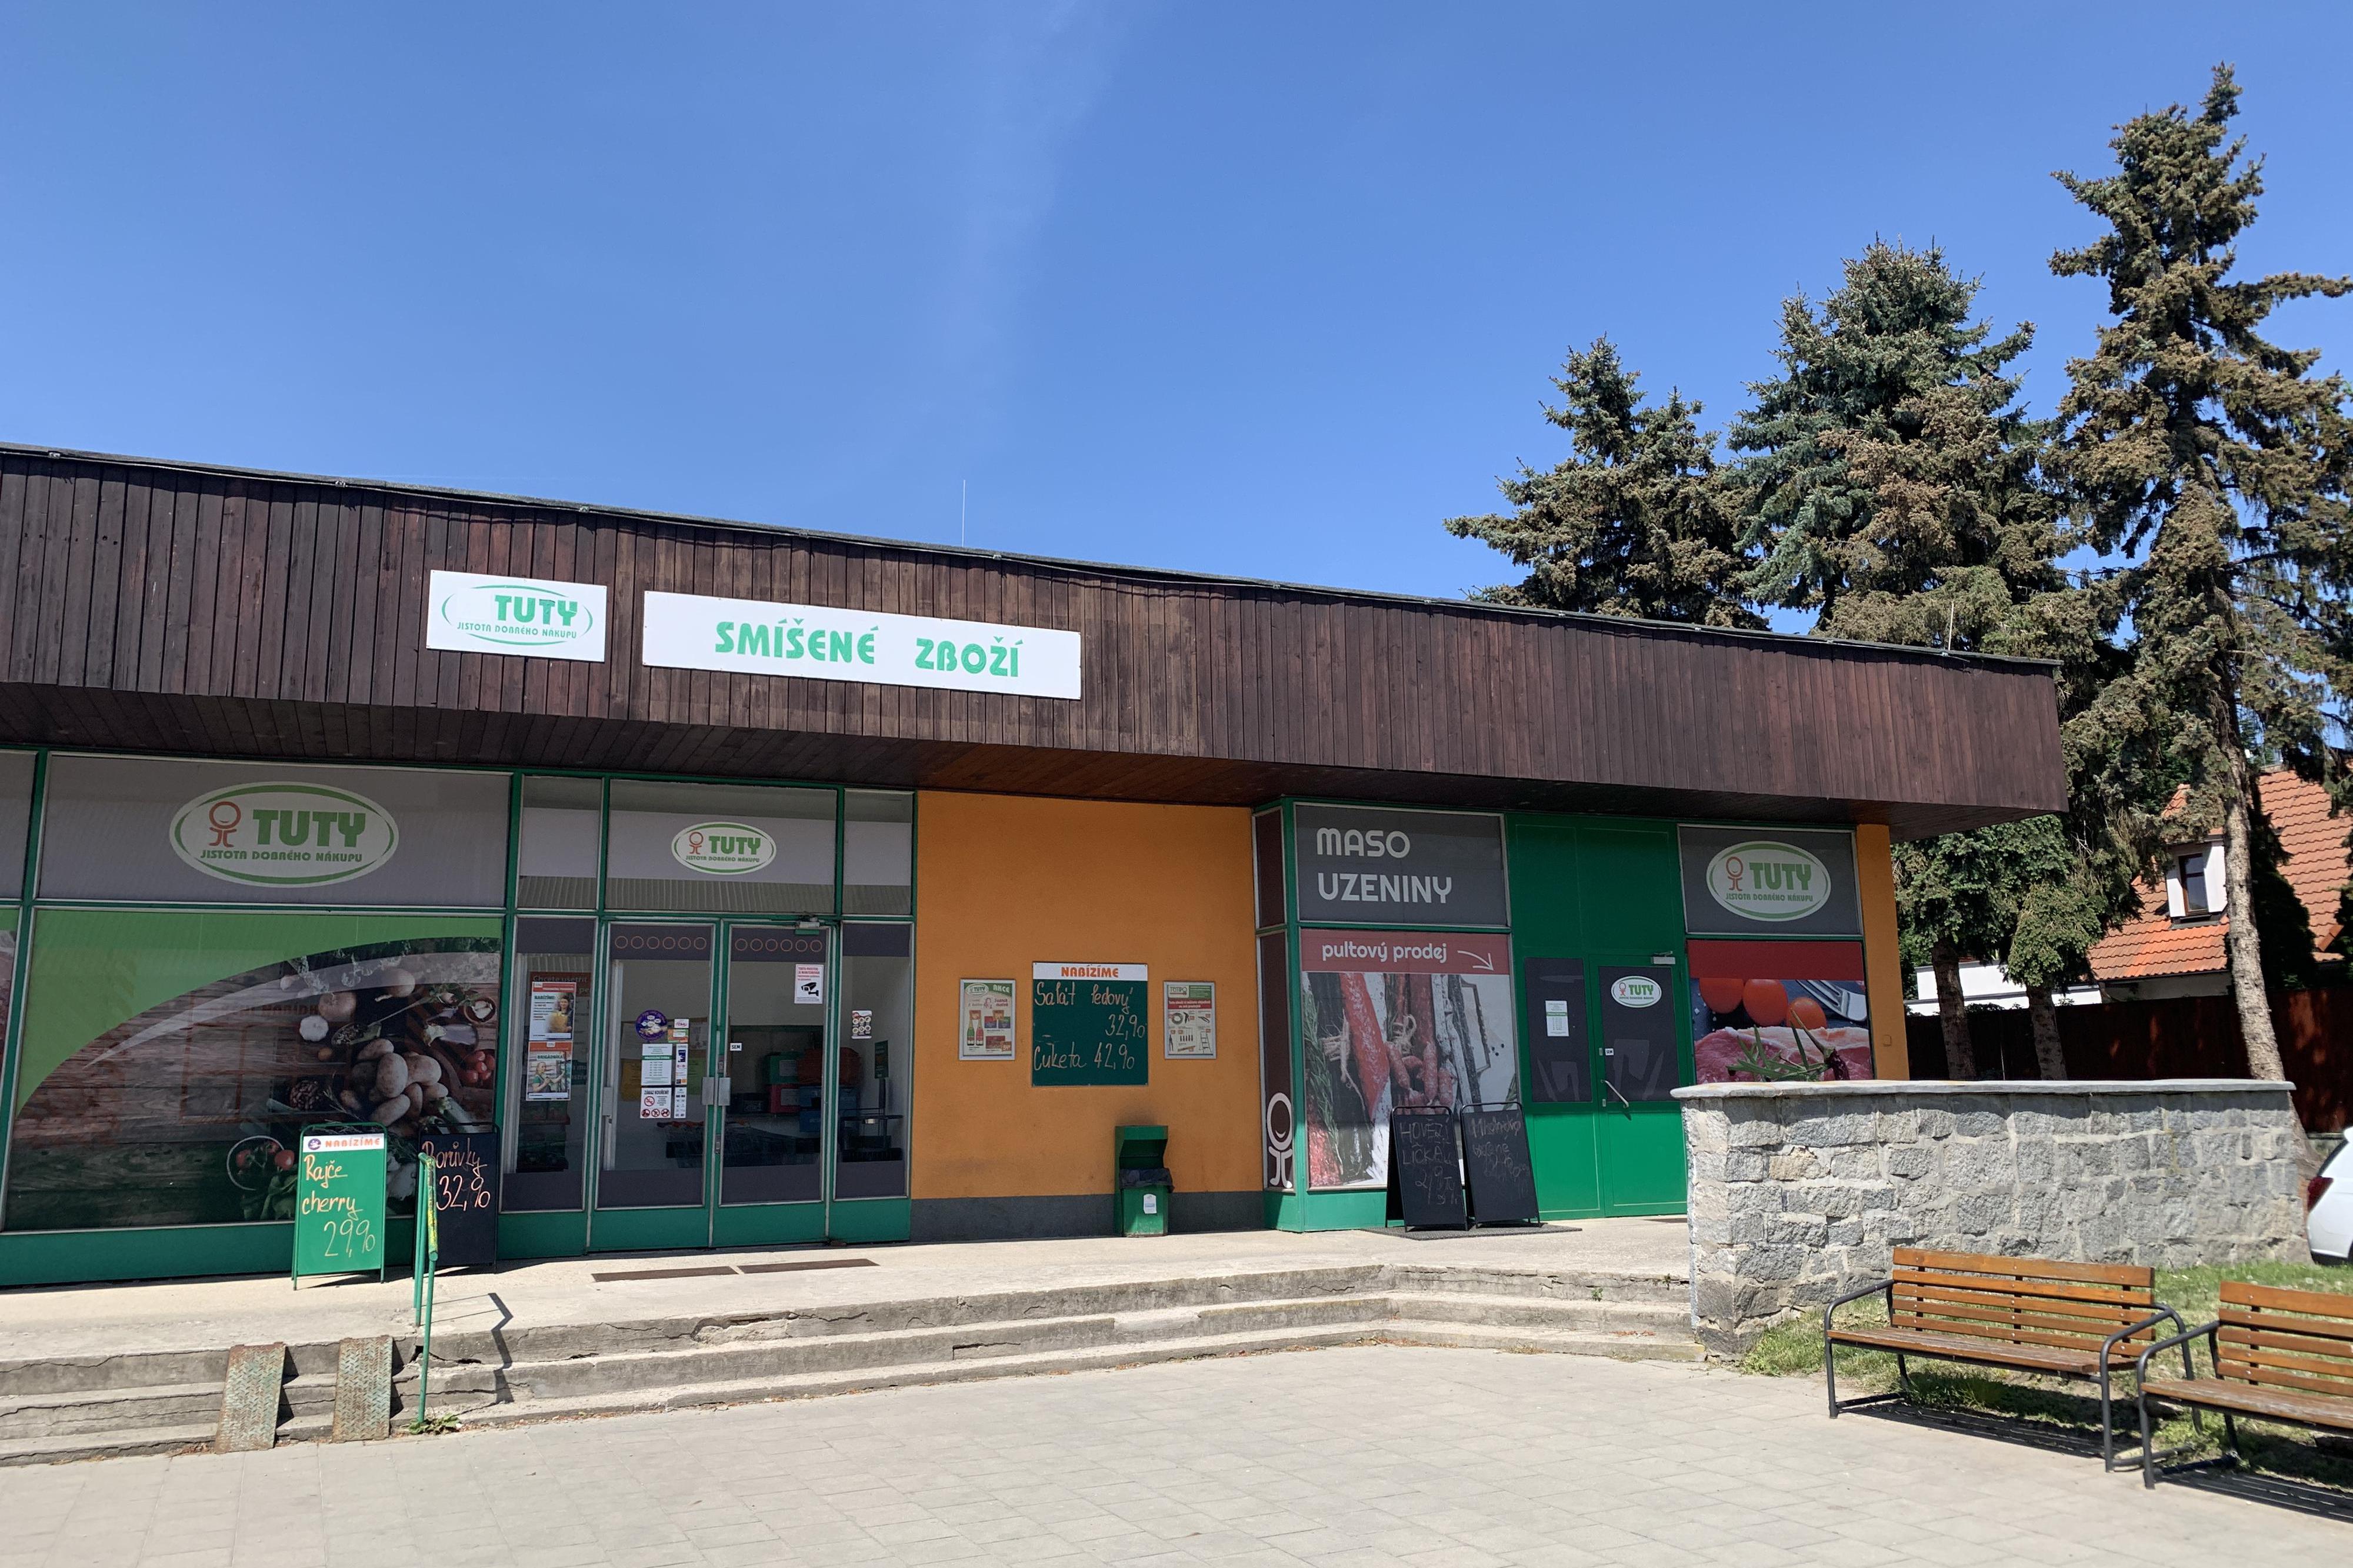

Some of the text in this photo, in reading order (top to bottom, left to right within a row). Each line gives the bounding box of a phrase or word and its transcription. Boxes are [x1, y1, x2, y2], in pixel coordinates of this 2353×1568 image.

[495, 595, 578, 626] TUTY
[457, 622, 576, 639] JISTOTA DOBRÉHO NÁKUPU
[715, 618, 1023, 677] SMÍŠENÉ ZBOŽÍ
[253, 809, 366, 848] TUTY
[201, 850, 362, 862] JISTOTA DOBRÉHO NÁKUPU
[709, 836, 761, 855] TUTY
[1317, 828, 1411, 858] MASO
[1318, 873, 1452, 903] UZENINY
[1749, 862, 1812, 890] TUTY
[1753, 893, 1785, 902] DOBRÉHO
[1322, 942, 1447, 963] pultový prodej
[1061, 964, 1119, 978] NABÍZÍME
[993, 984, 1010, 993] AKCE
[1035, 981, 1134, 1015] Salát ledový
[1628, 985, 1654, 995] TUTY
[1105, 1014, 1145, 1040] 32,90
[1034, 1042, 1135, 1070] Cuketa 42,90
[325, 1136, 380, 1148] NABÍZÍME
[304, 1154, 348, 1189] Rajče
[301, 1190, 364, 1220] cherry
[436, 1175, 491, 1212] 32,90
[324, 1219, 375, 1258] 29,90
